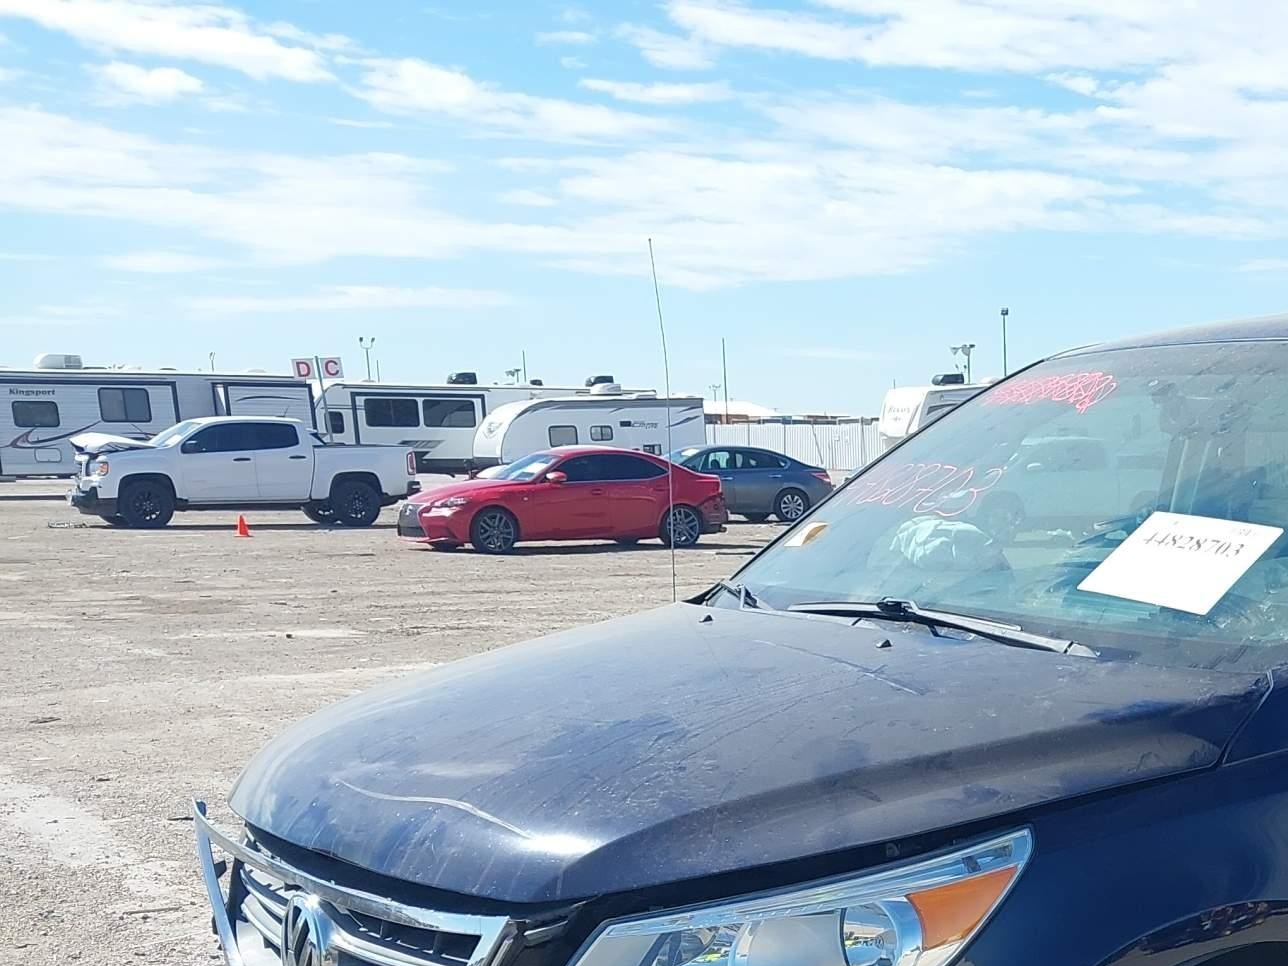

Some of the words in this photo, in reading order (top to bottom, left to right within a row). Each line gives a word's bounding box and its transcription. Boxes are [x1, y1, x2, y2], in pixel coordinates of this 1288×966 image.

[295, 361, 311, 377] D
[325, 360, 340, 376] C
[9, 388, 56, 396] Kingsport
[1143, 531, 1245, 558] 44828703
